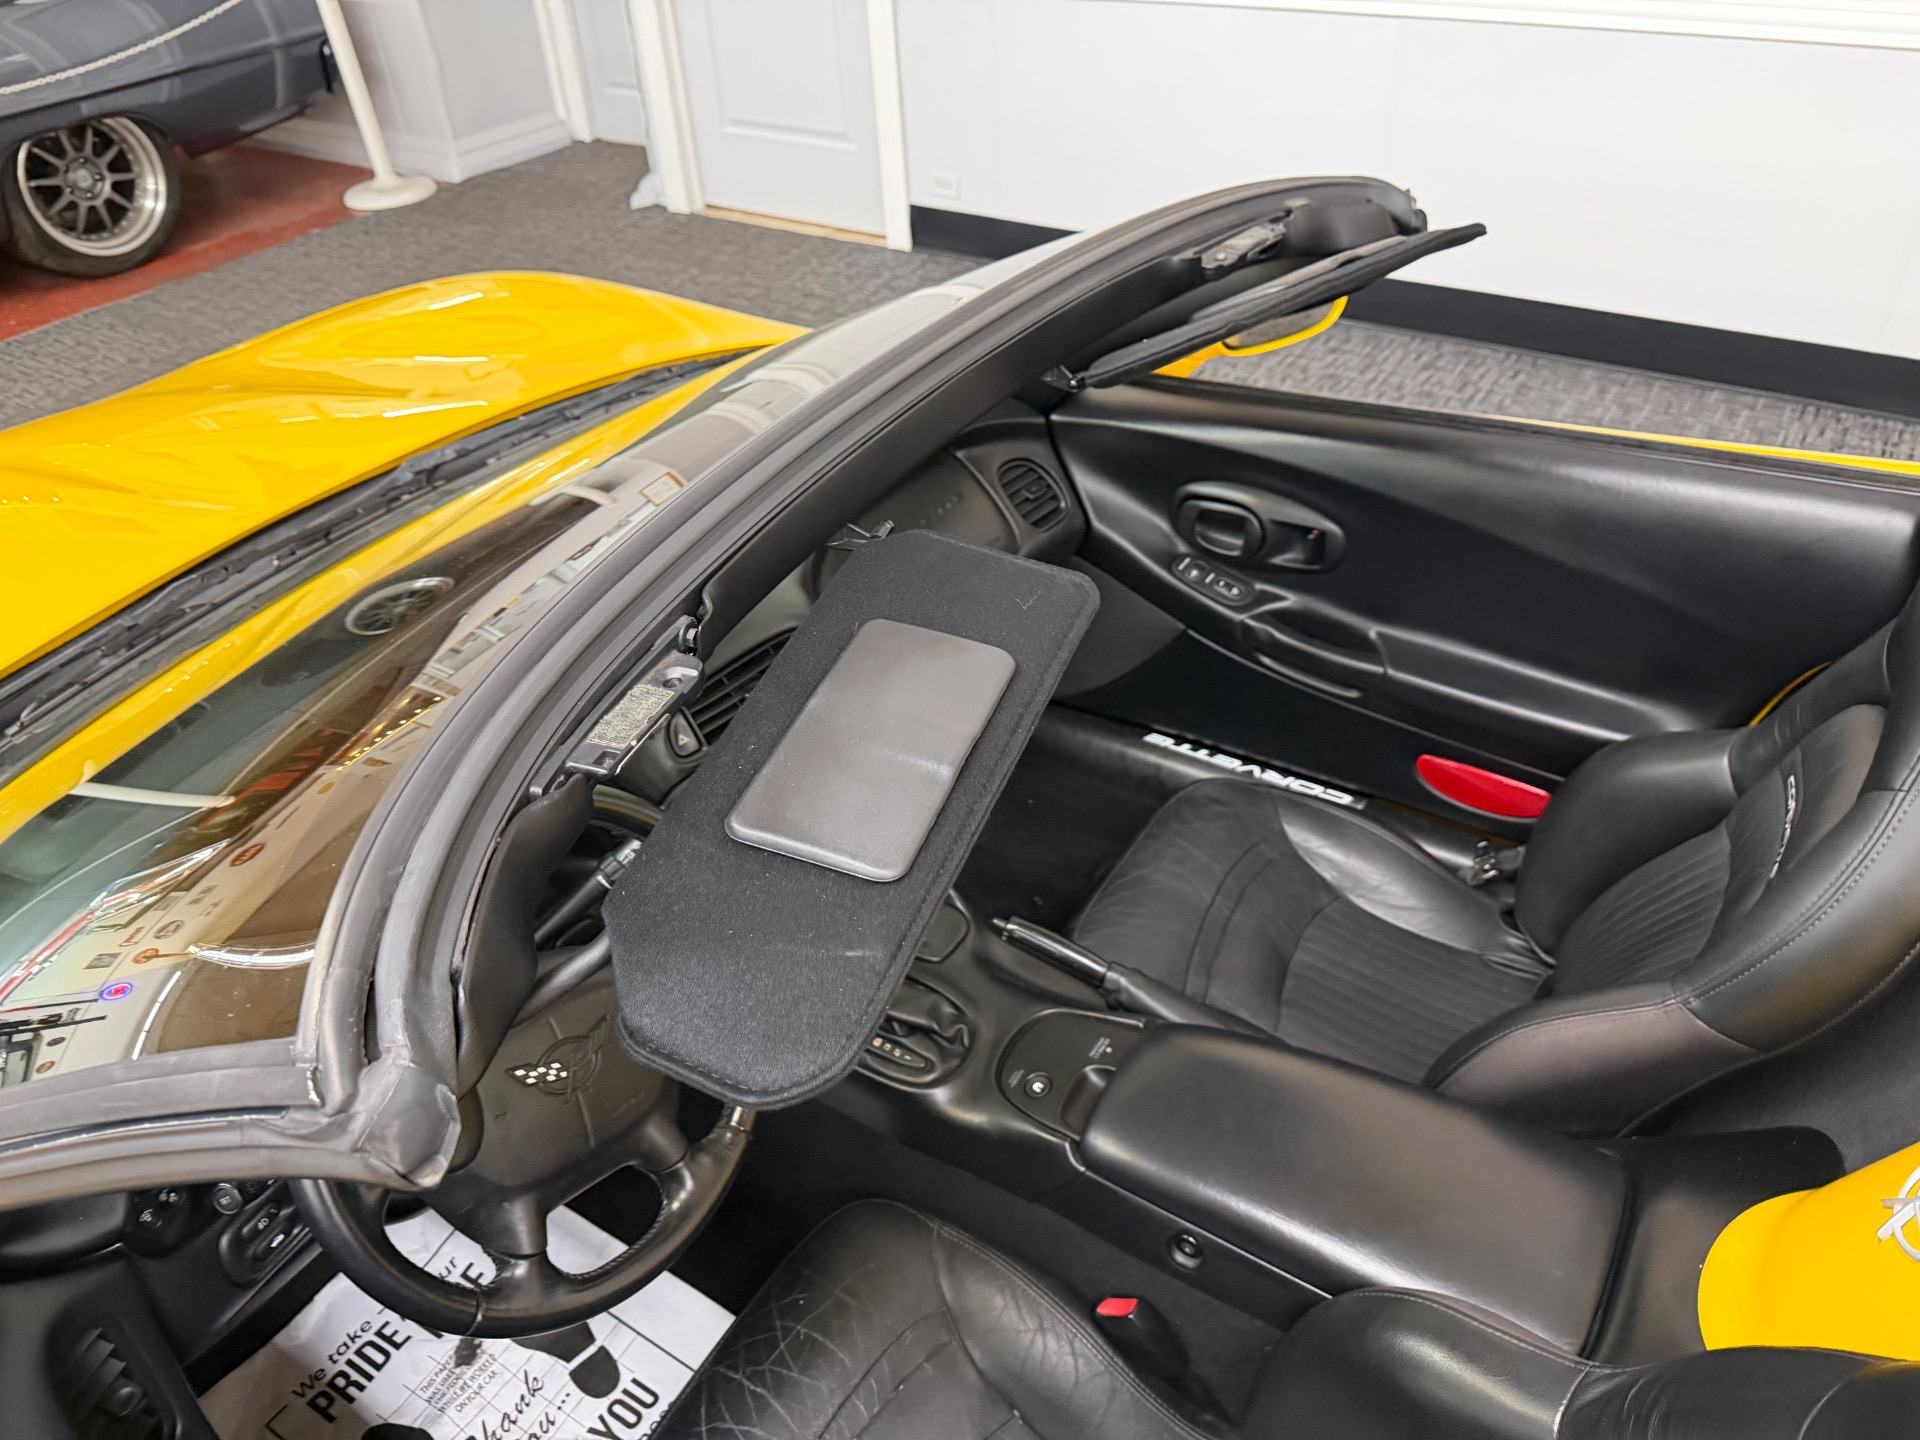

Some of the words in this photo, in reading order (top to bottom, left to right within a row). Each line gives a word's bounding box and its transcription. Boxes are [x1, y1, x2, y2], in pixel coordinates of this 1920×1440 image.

[1142, 737, 1354, 805] CORVETTE
[291, 1368, 327, 1398] We
[328, 1320, 373, 1364] take
[305, 1320, 412, 1423] PRIDE
[586, 1377, 659, 1440] YOU
